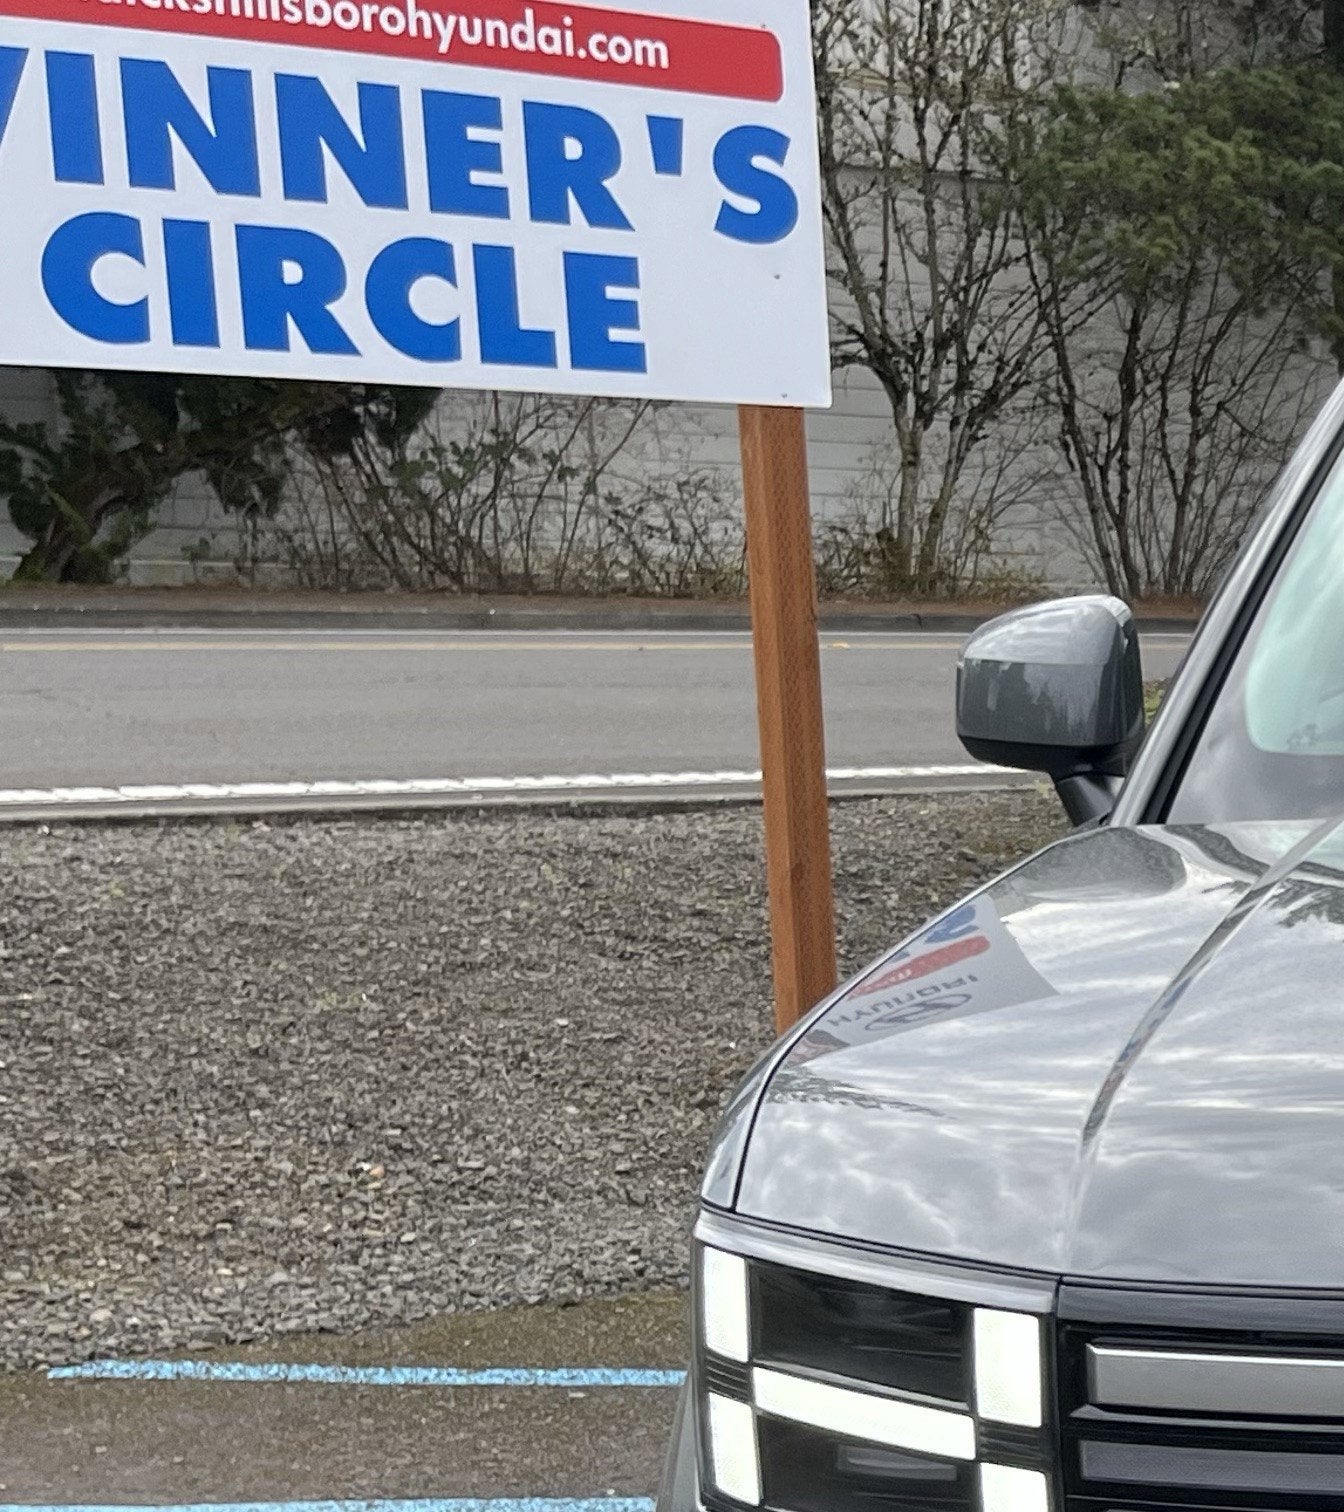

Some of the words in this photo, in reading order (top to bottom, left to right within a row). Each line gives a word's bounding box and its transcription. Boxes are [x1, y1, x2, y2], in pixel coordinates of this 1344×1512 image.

[100, 0, 669, 69] slsborohyundai.com
[0, 46, 801, 245] INNER'S
[41, 212, 648, 374] CIRCLE
